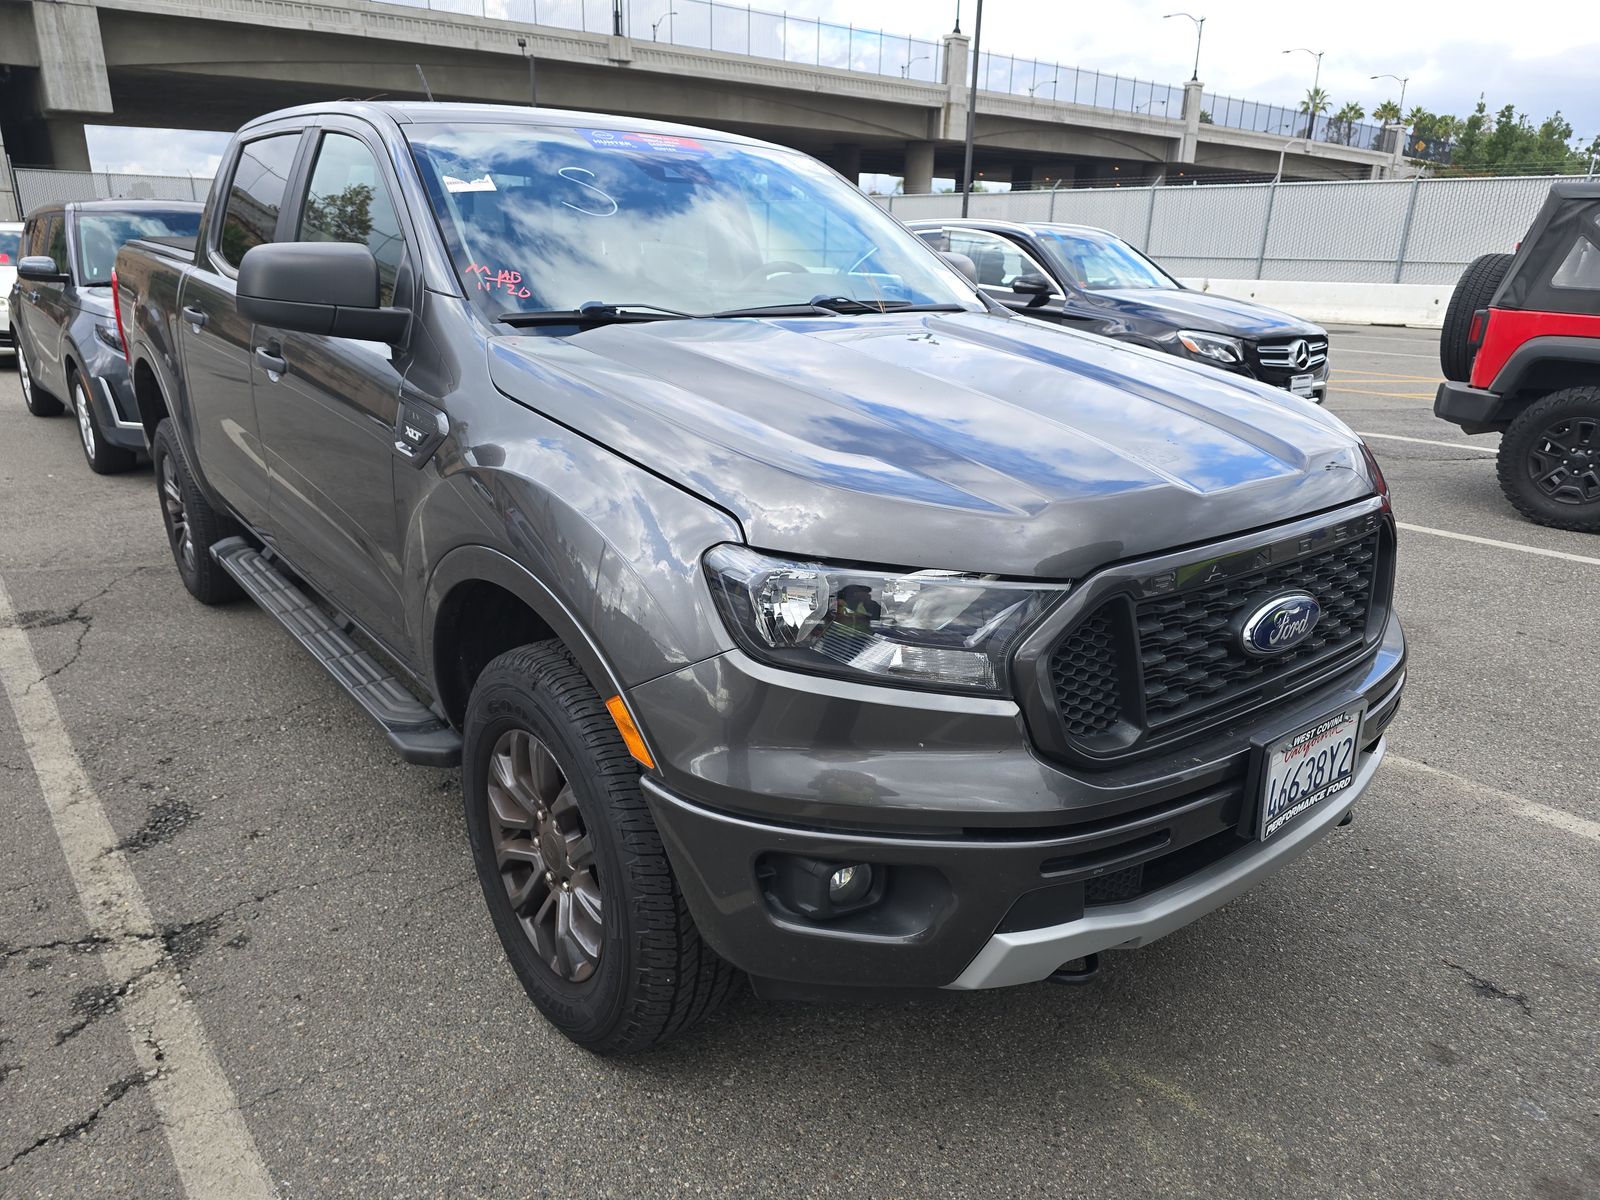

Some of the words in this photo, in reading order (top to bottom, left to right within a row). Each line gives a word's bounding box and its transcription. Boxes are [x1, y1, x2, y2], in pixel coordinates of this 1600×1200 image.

[558, 166, 618, 217] S
[404, 425, 422, 441] XLT
[1151, 515, 1378, 594] RANGER
[1269, 605, 1311, 645] Ford
[1293, 728, 1317, 747] WEST
[1316, 714, 1344, 735] COVINA
[1267, 736, 1353, 819] 46638Y2
[1265, 789, 1327, 837] PERFORMANCE
[1326, 776, 1353, 797] FORD
